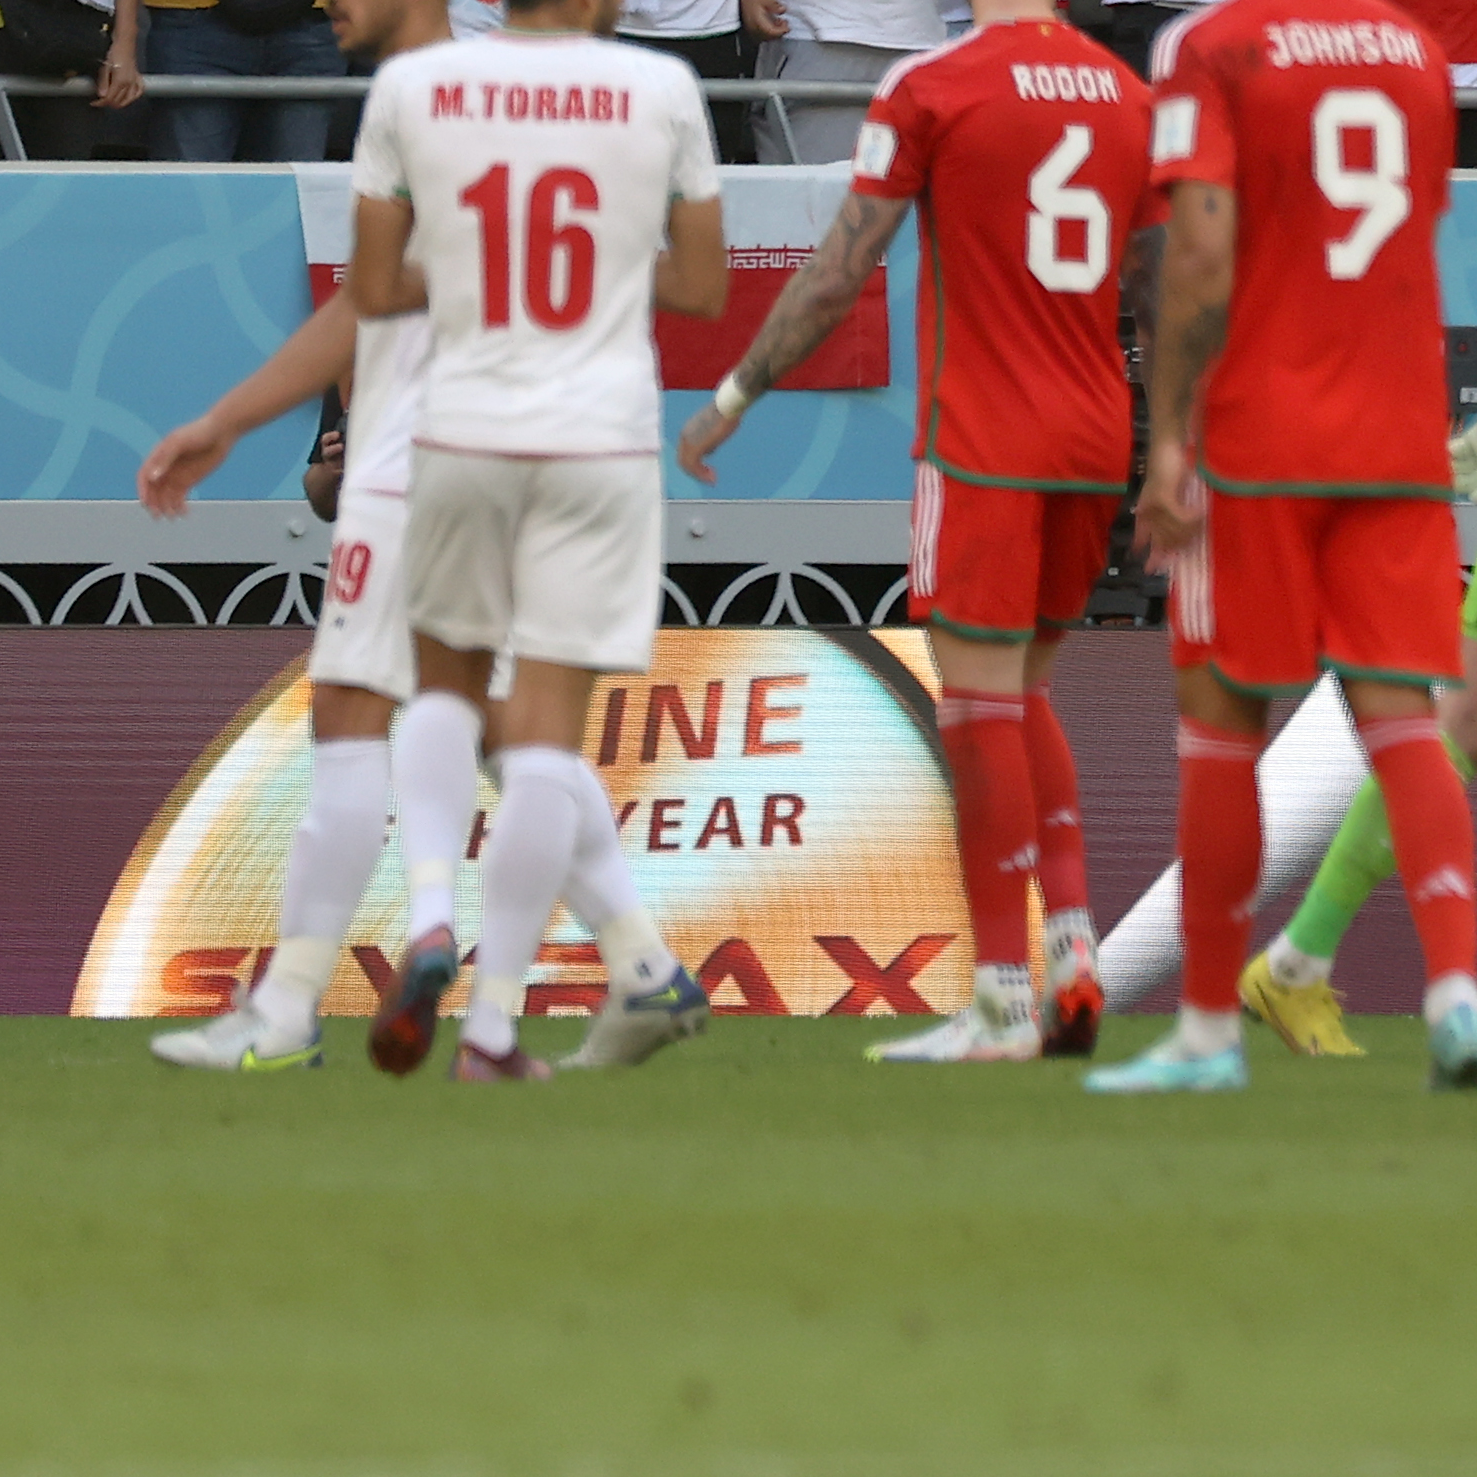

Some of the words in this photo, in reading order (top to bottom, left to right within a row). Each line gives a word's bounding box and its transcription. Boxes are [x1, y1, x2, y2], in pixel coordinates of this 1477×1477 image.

[1011, 64, 1121, 105] RODON
[1265, 20, 1424, 73] JOHNSON
[431, 82, 631, 124] M.TORABI
[1027, 124, 1109, 293] 6
[1312, 89, 1411, 281] 9
[461, 161, 601, 330] 16
